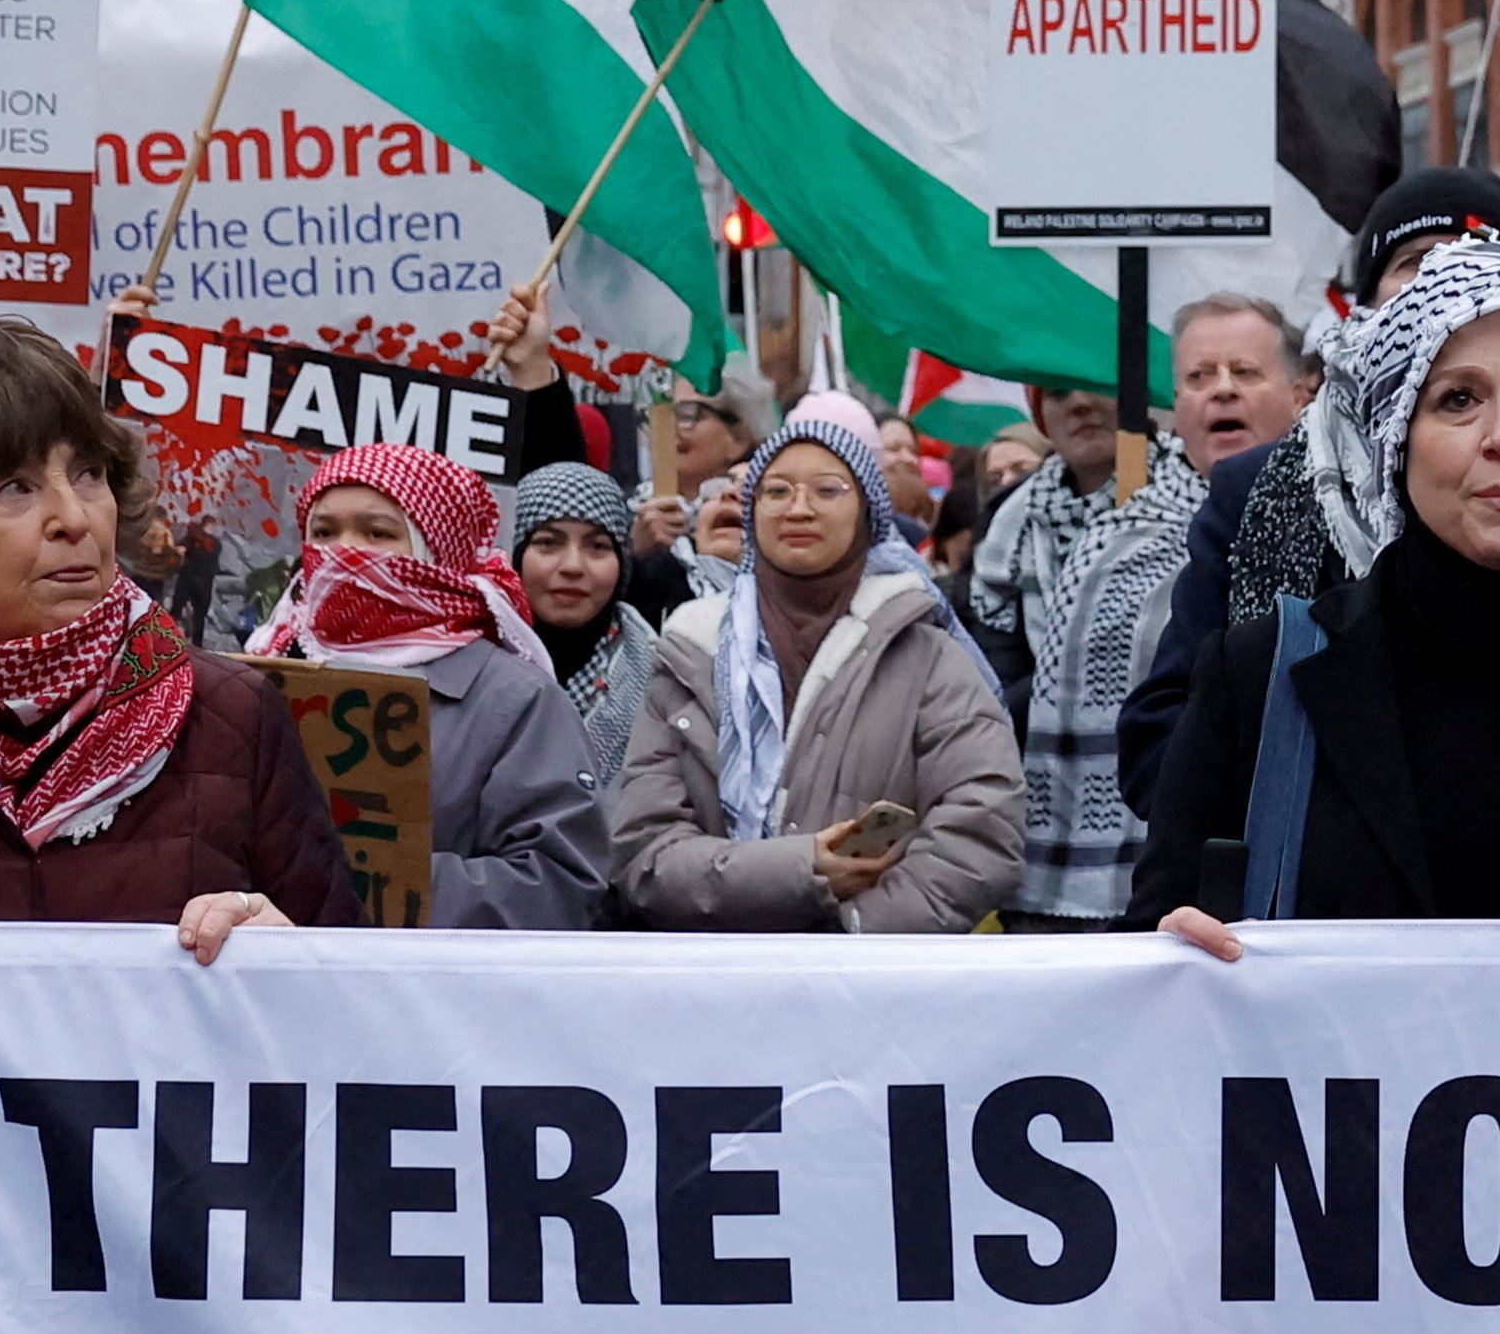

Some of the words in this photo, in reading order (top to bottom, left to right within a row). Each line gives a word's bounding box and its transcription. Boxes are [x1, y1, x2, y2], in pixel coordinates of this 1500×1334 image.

[115, 209, 159, 251] of
[175, 208, 249, 250] the
[263, 202, 461, 247] Children
[192, 255, 318, 301] Killed
[336, 259, 375, 295] in
[392, 254, 502, 295] Gaza
[120, 331, 510, 475] SHAME
[887, 1075, 1118, 1306] IS
